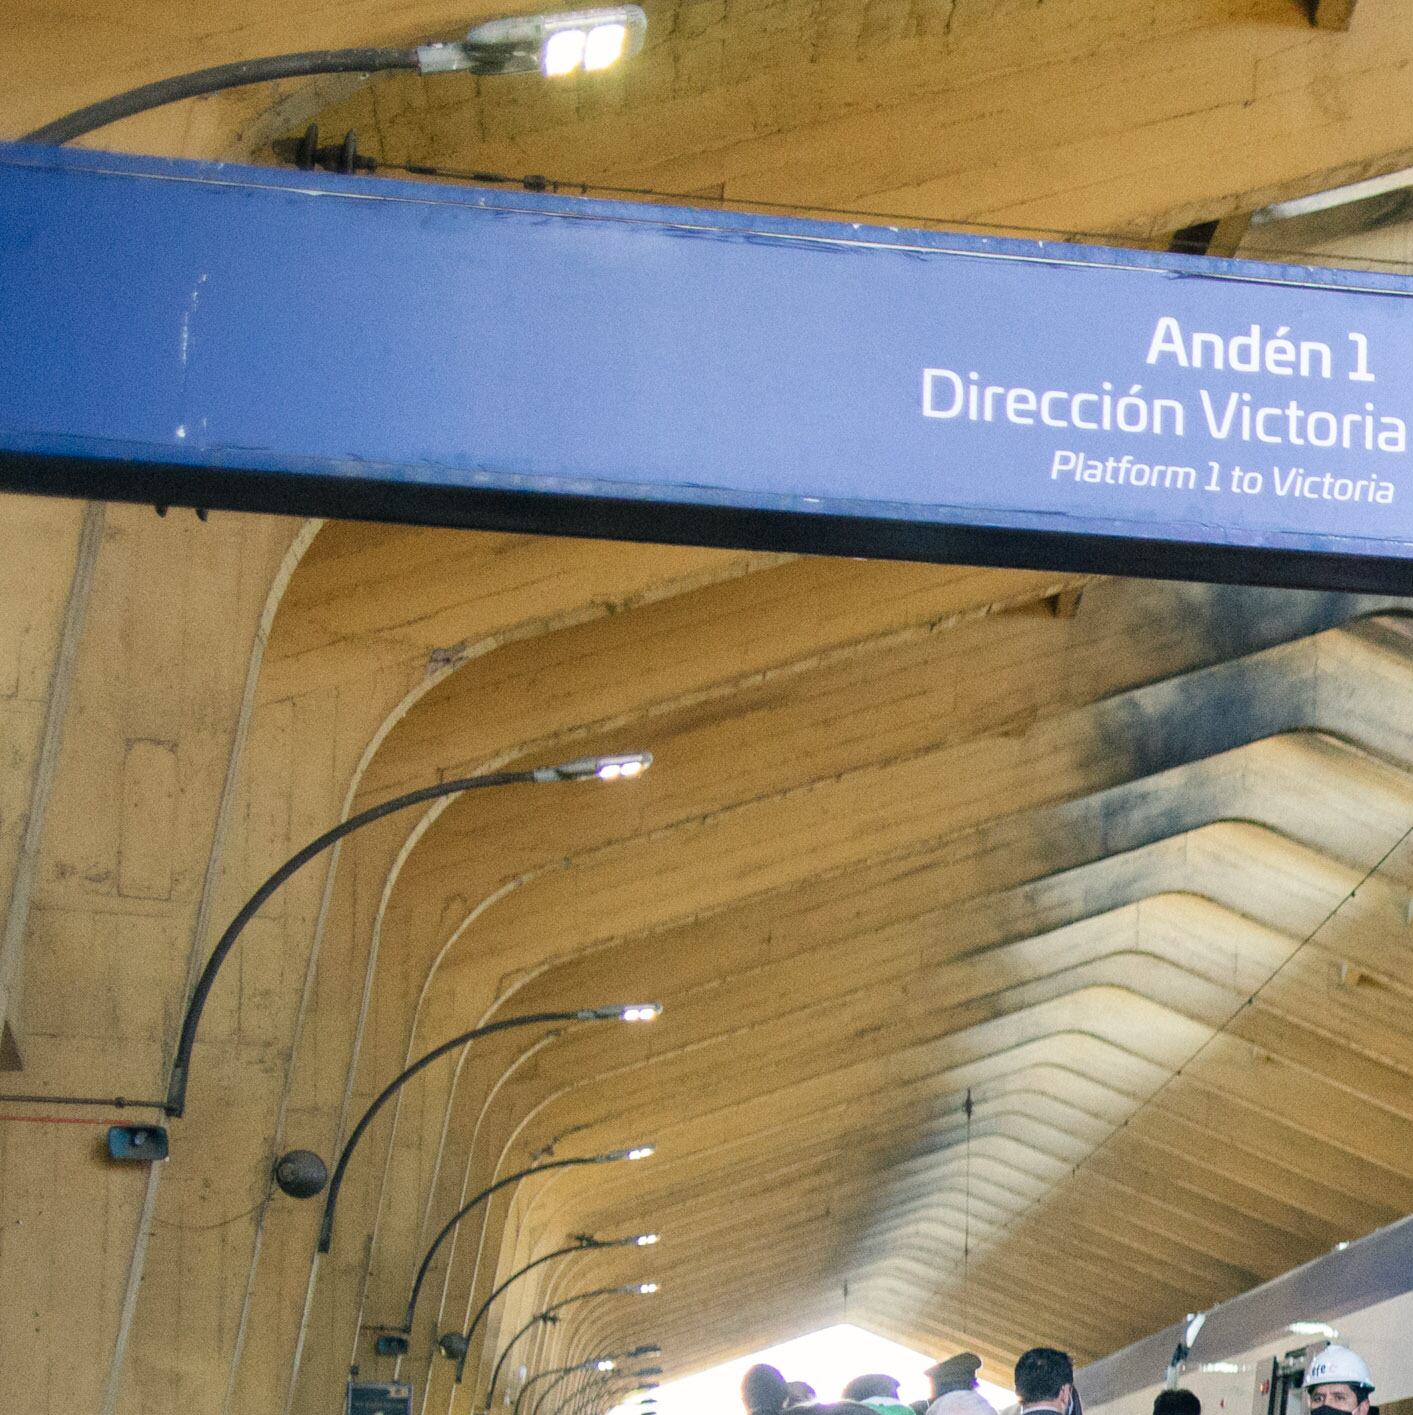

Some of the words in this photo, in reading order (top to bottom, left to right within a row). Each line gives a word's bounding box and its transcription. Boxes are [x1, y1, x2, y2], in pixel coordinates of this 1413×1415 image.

[1145, 316, 1332, 379] Andén
[1348, 331, 1376, 383] 1
[922, 367, 1184, 436] Dirección
[1199, 389, 1407, 453] Victoria
[1050, 450, 1197, 490] Platform
[1204, 461, 1221, 492] 1
[1231, 465, 1264, 495] to
[1272, 466, 1395, 504] Victoria
